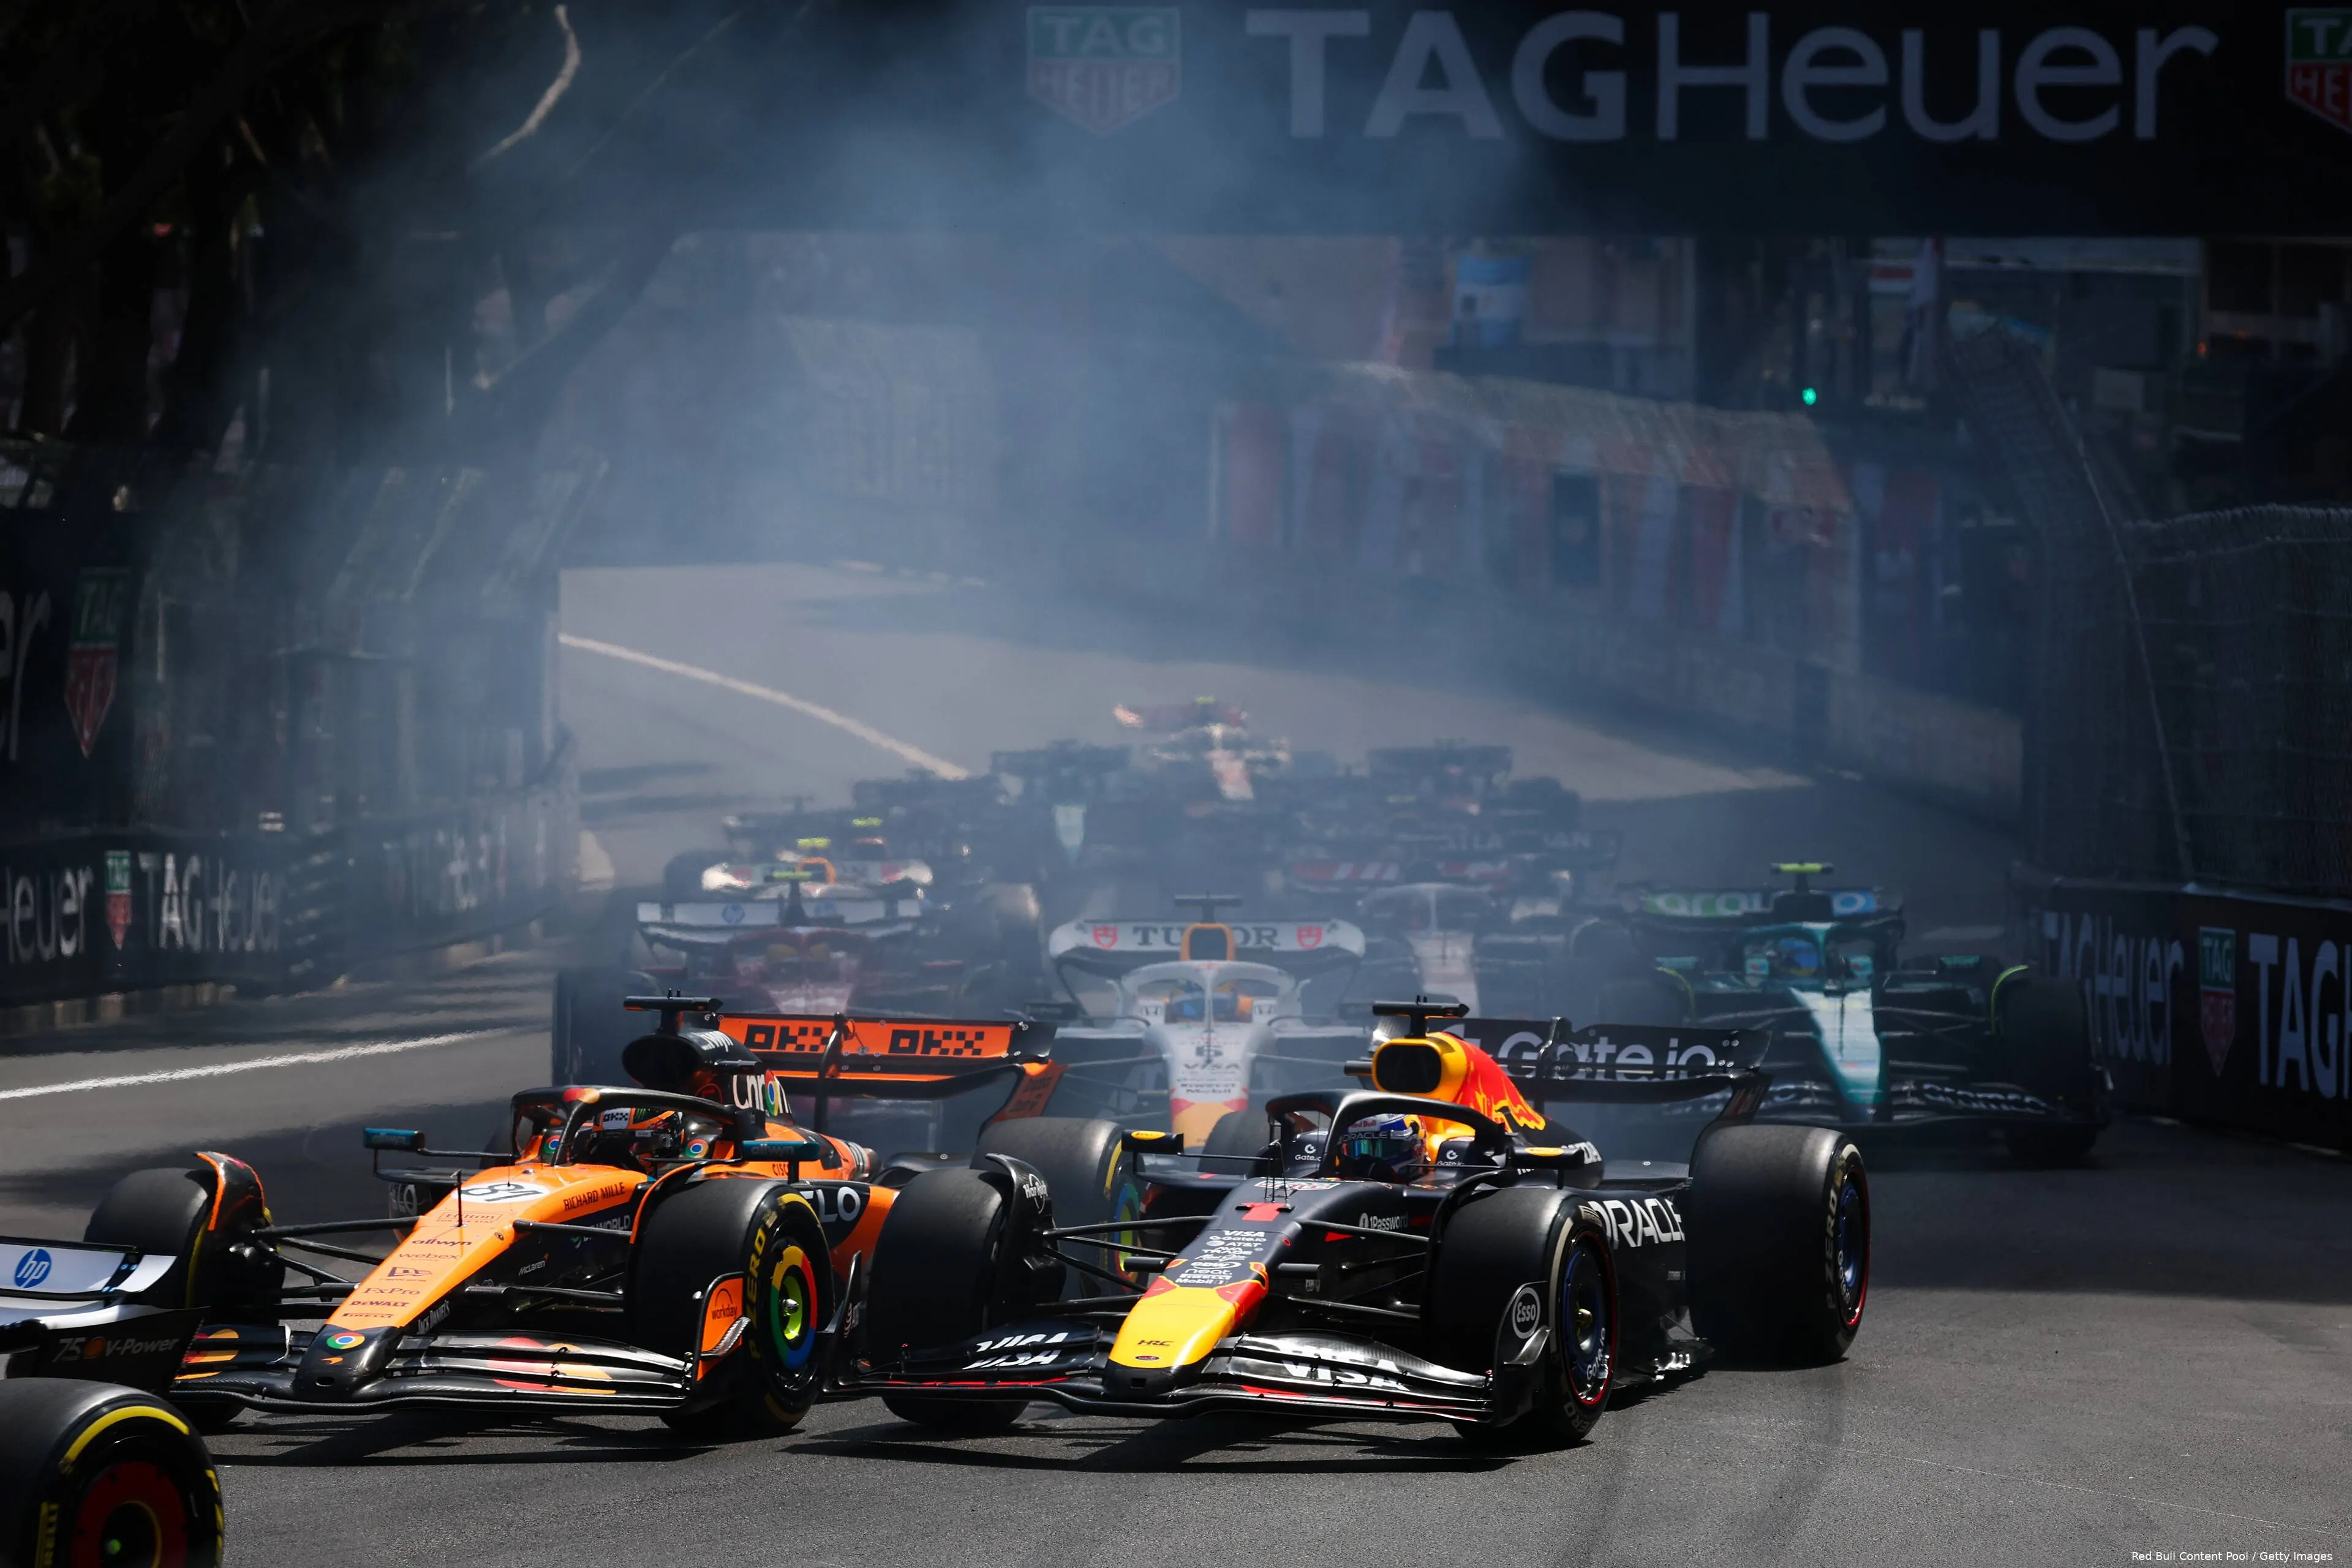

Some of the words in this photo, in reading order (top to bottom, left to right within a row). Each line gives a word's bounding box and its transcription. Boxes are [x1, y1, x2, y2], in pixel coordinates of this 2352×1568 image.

[1042, 17, 1165, 55] TAG
[1133, 925, 1280, 947] TUOR
[888, 1029, 984, 1055] OKX
[1497, 1031, 1717, 1082] Gate.io
[1342, 1132, 1389, 1142] ORACLE
[460, 1183, 545, 1202] 81
[563, 1191, 599, 1212] RICHARD
[600, 1182, 626, 1200] MILLE
[1241, 1202, 1287, 1221] 1
[1370, 1213, 1408, 1231] 1Password
[16, 1249, 51, 1287] hp
[518, 1260, 546, 1276] McLaren
[745, 1227, 767, 1330] ZERO
[711, 1303, 738, 1320] workday
[51, 1336, 86, 1363] 75
[105, 1337, 181, 1357] V-Power
